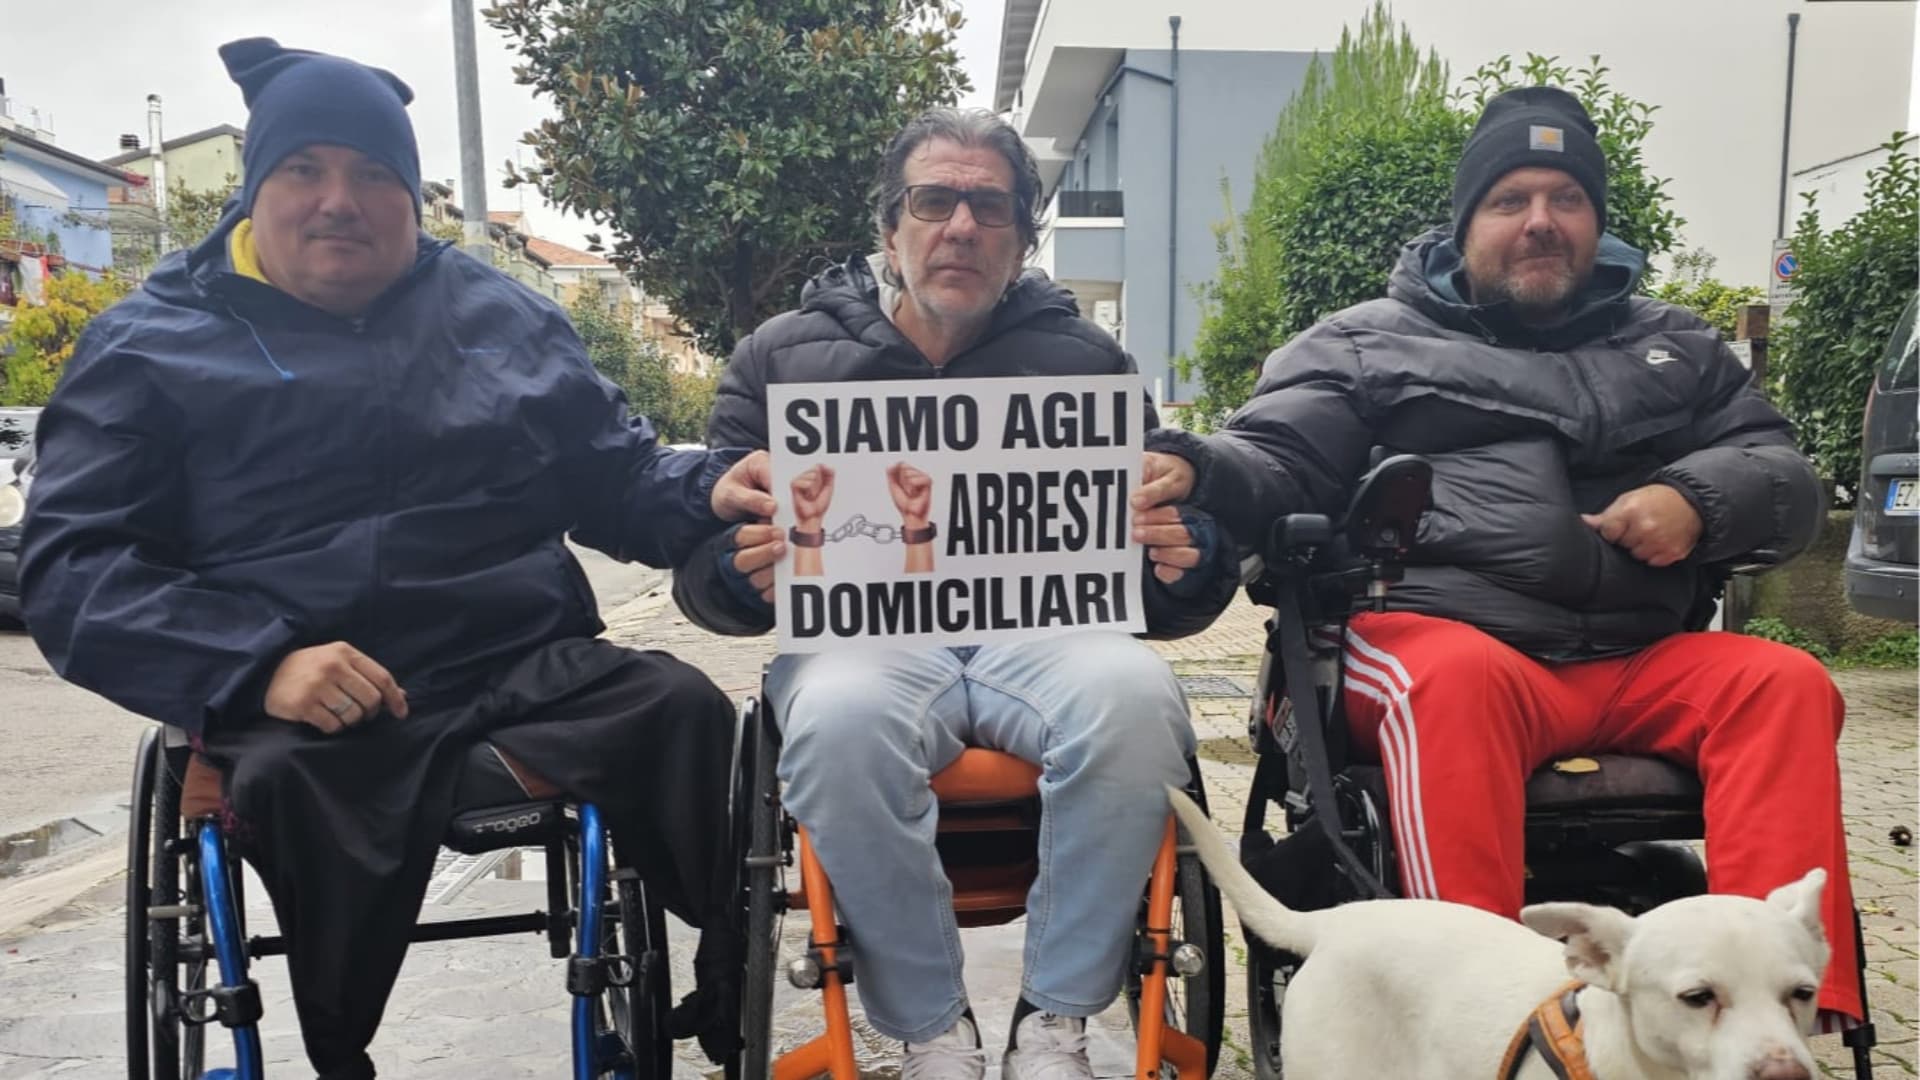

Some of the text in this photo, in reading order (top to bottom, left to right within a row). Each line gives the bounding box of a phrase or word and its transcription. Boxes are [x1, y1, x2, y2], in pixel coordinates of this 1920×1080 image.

[785, 391, 1127, 456] SIAMO AGLI
[946, 469, 1128, 557] ARRESTI
[790, 572, 1128, 639] DOMICILIARI
